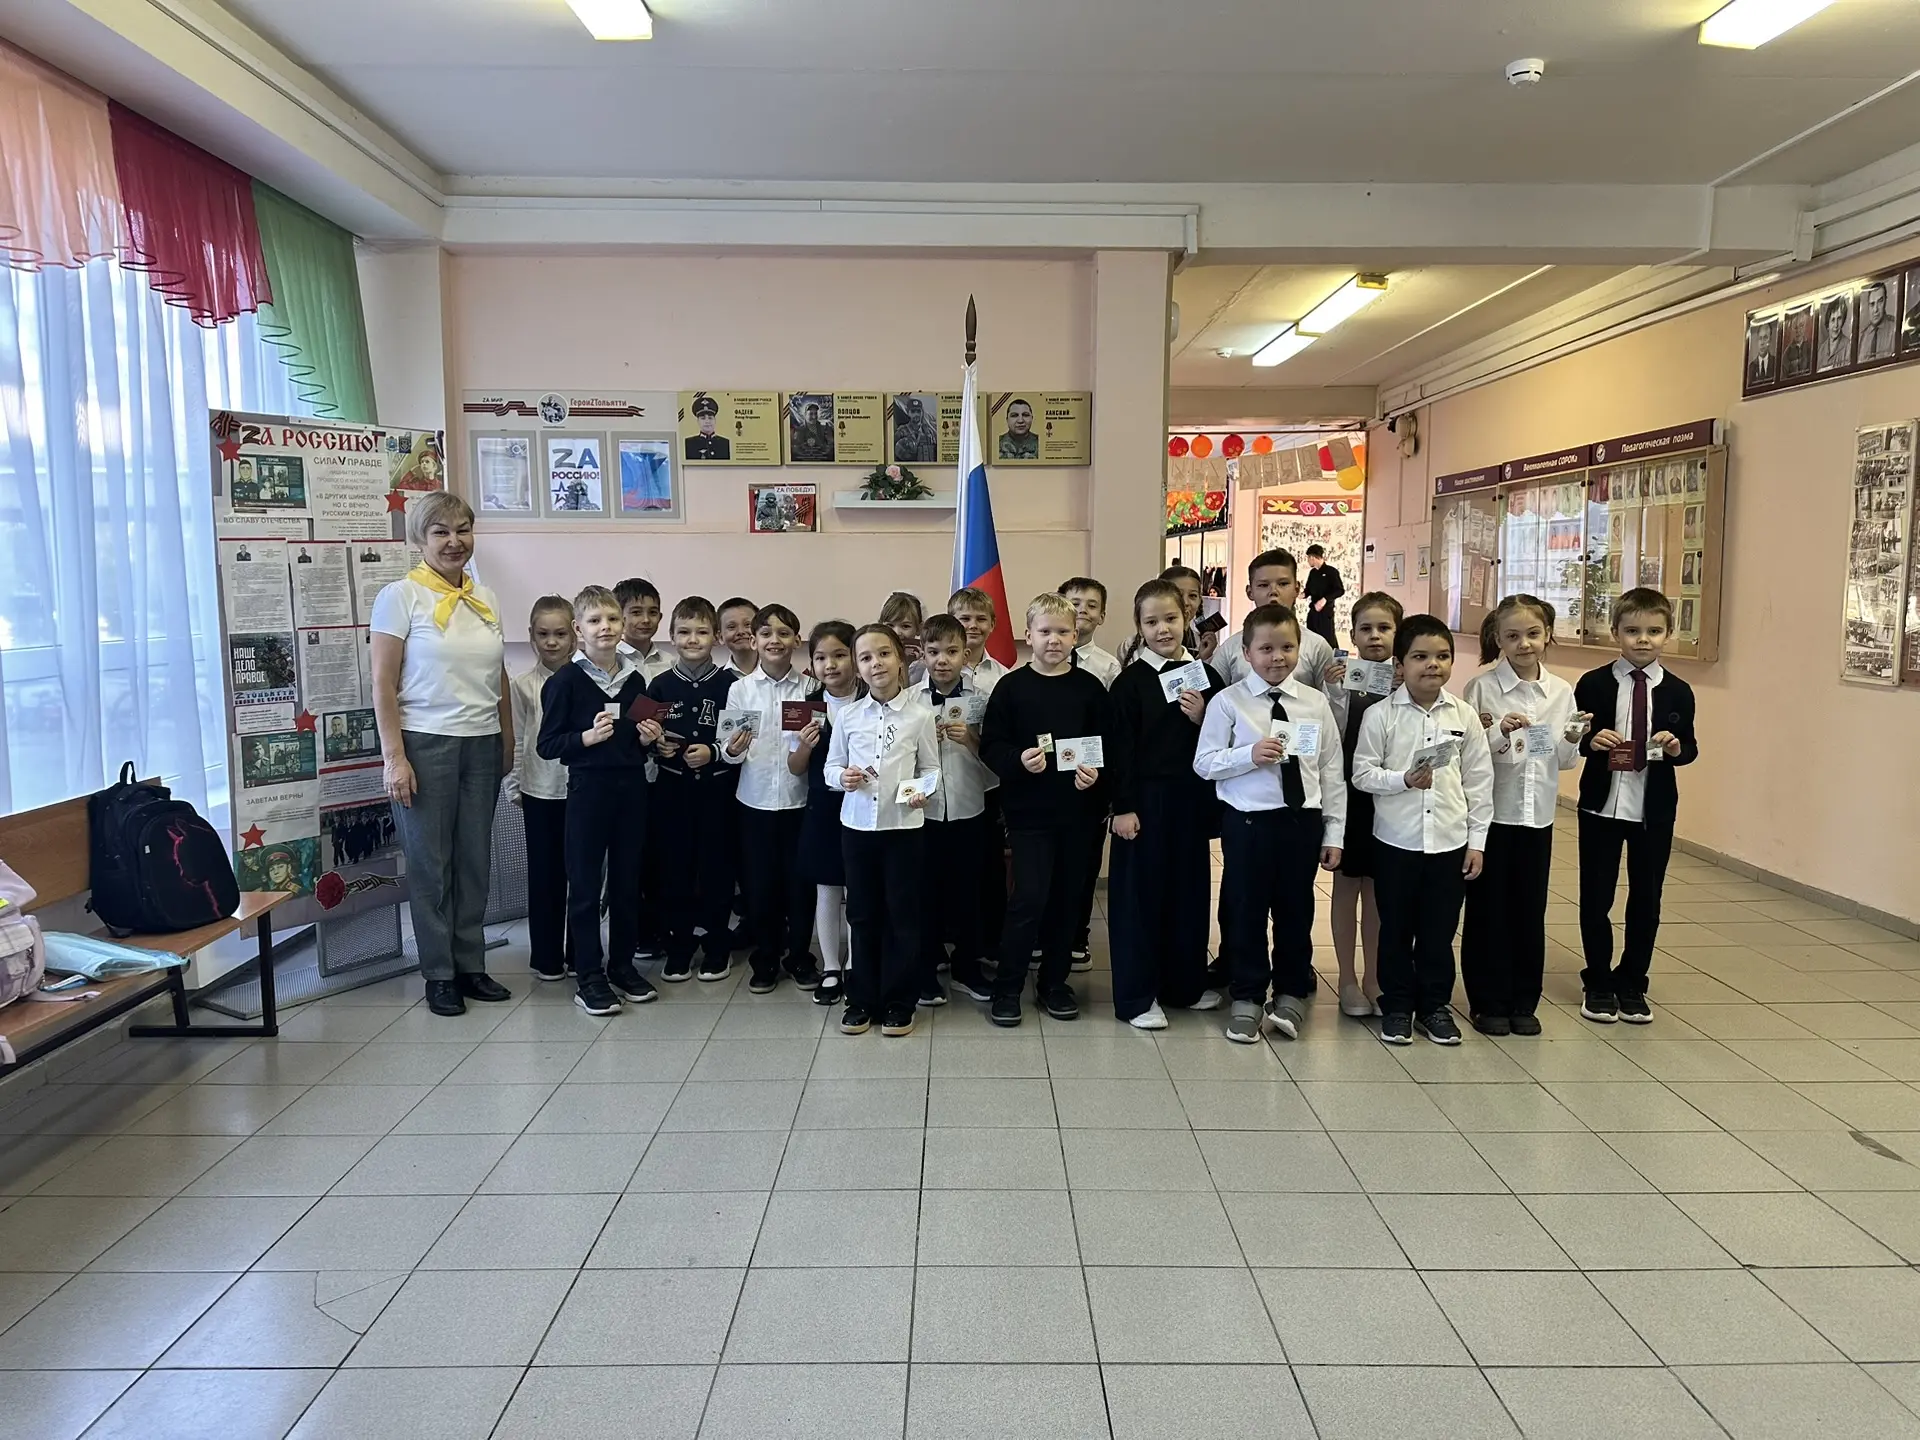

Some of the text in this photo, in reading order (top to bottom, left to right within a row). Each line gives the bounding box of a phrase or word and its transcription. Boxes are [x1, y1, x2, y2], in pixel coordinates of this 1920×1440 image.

[282, 428, 386, 453] РОССИЮ!
[1621, 432, 1694, 453] Педагогическая поэма
[313, 456, 338, 465] СИЛА
[348, 458, 382, 467] ПРАВДЕ
[552, 471, 600, 480] РОССИЮ!
[233, 647, 256, 660] НАШЕ
[235, 659, 256, 673] ДЕЛО
[235, 671, 266, 684] ПРАВОЕ
[246, 793, 304, 805] ЗАВЕТАМ ВЕРНЫ
